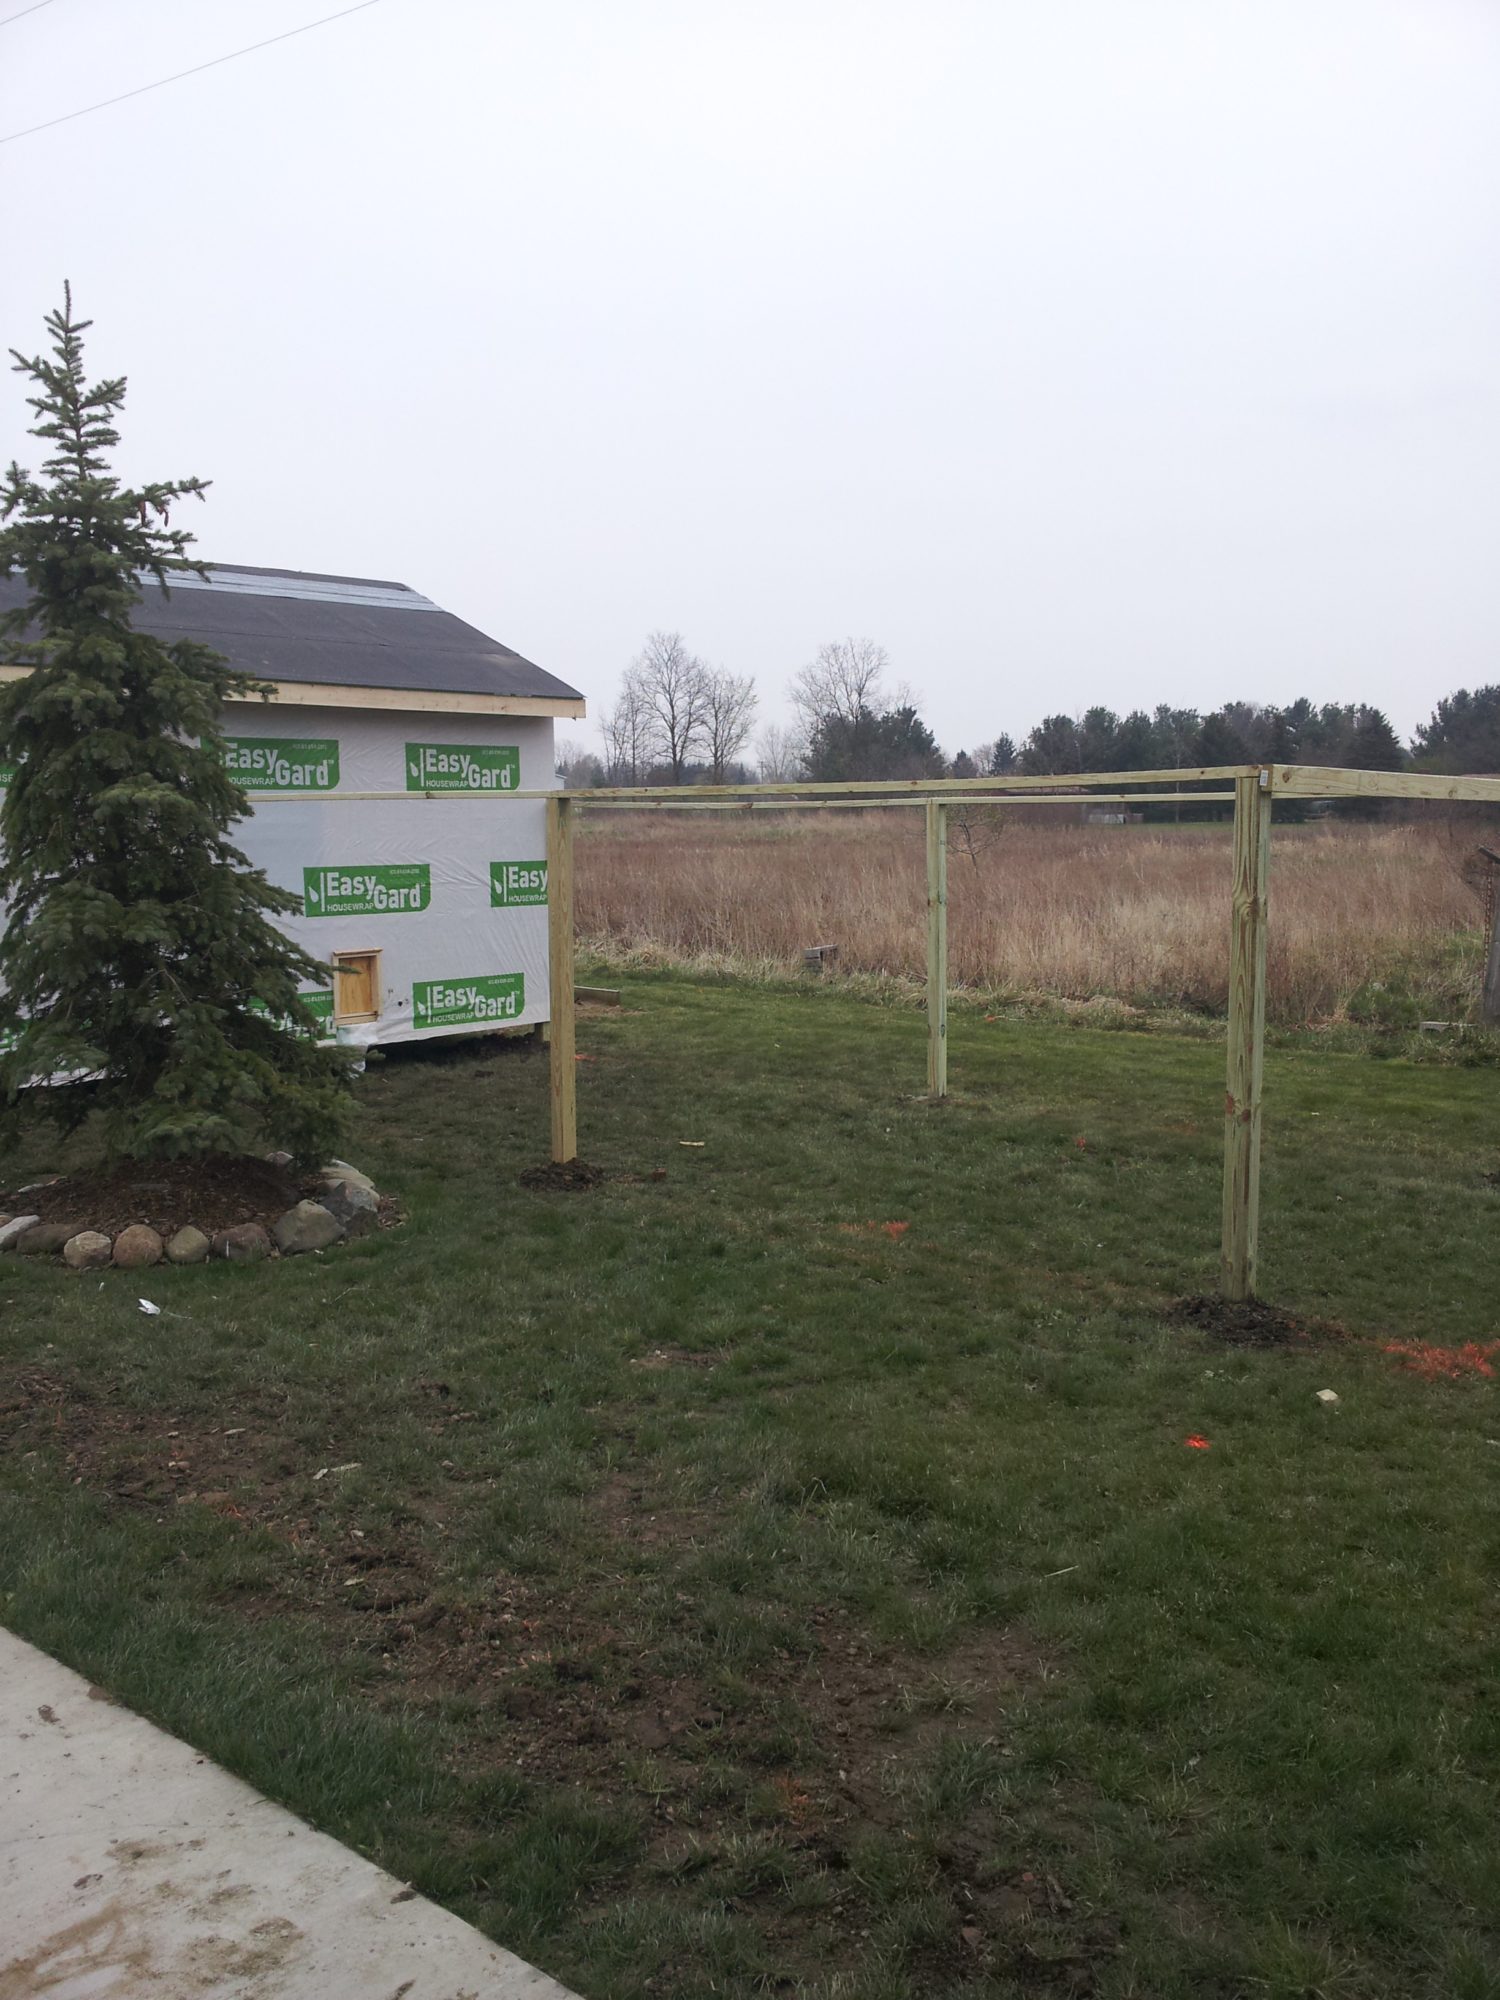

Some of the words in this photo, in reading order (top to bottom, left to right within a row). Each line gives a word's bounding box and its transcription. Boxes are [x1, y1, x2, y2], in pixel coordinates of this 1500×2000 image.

[224, 742, 278, 775] Easy
[275, 760, 329, 786] Gard
[425, 749, 471, 778] Easy
[468, 764, 511, 788] Gard
[228, 776, 275, 786] OUSEWRAP
[426, 780, 469, 788] HOUSEWRAP
[326, 872, 377, 900] Easy
[373, 883, 421, 909] Gard
[508, 866, 548, 892] Easy
[327, 903, 374, 912] HOUSEWRAP
[432, 985, 477, 1009] Easy
[474, 991, 516, 1018] Gard
[432, 1012, 474, 1023] HOUSEWRAP
